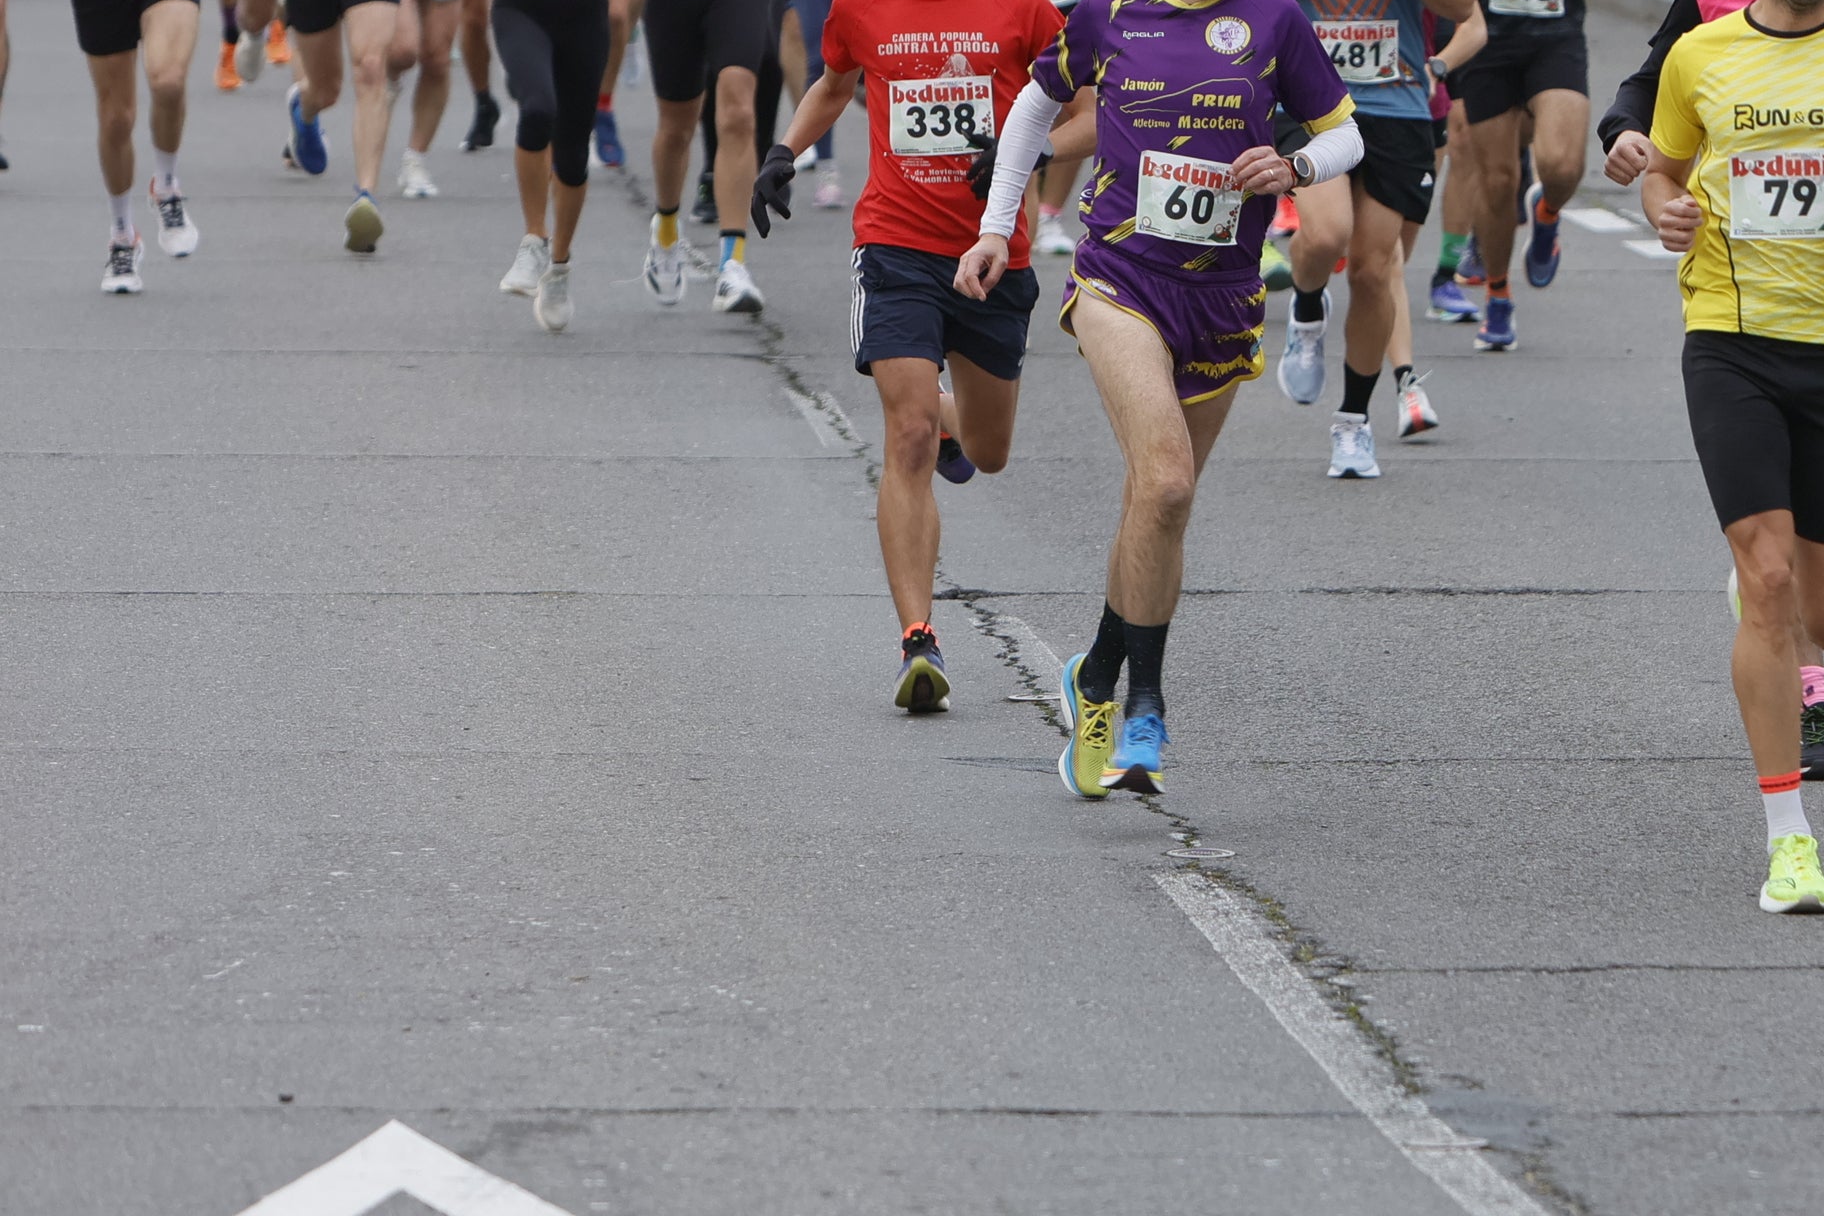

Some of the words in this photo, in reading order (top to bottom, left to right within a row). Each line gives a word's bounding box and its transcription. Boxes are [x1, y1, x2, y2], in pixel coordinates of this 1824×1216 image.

[892, 32, 935, 43] CARRERA
[940, 31, 983, 42] POPULAR
[1315, 24, 1397, 42] bedunia
[877, 41, 929, 56] CONTRA
[933, 42, 949, 53] LA
[953, 41, 1000, 54] DROGA
[1330, 41, 1383, 69] 481
[892, 82, 990, 104] bedunia
[1120, 77, 1166, 91] Jamón
[1191, 93, 1242, 109] PRIM
[906, 103, 976, 139] 338
[1132, 118, 1171, 128] Atletismo
[1177, 115, 1245, 130] Macotera
[1164, 184, 1215, 225] 60
[1763, 179, 1818, 217] 79
